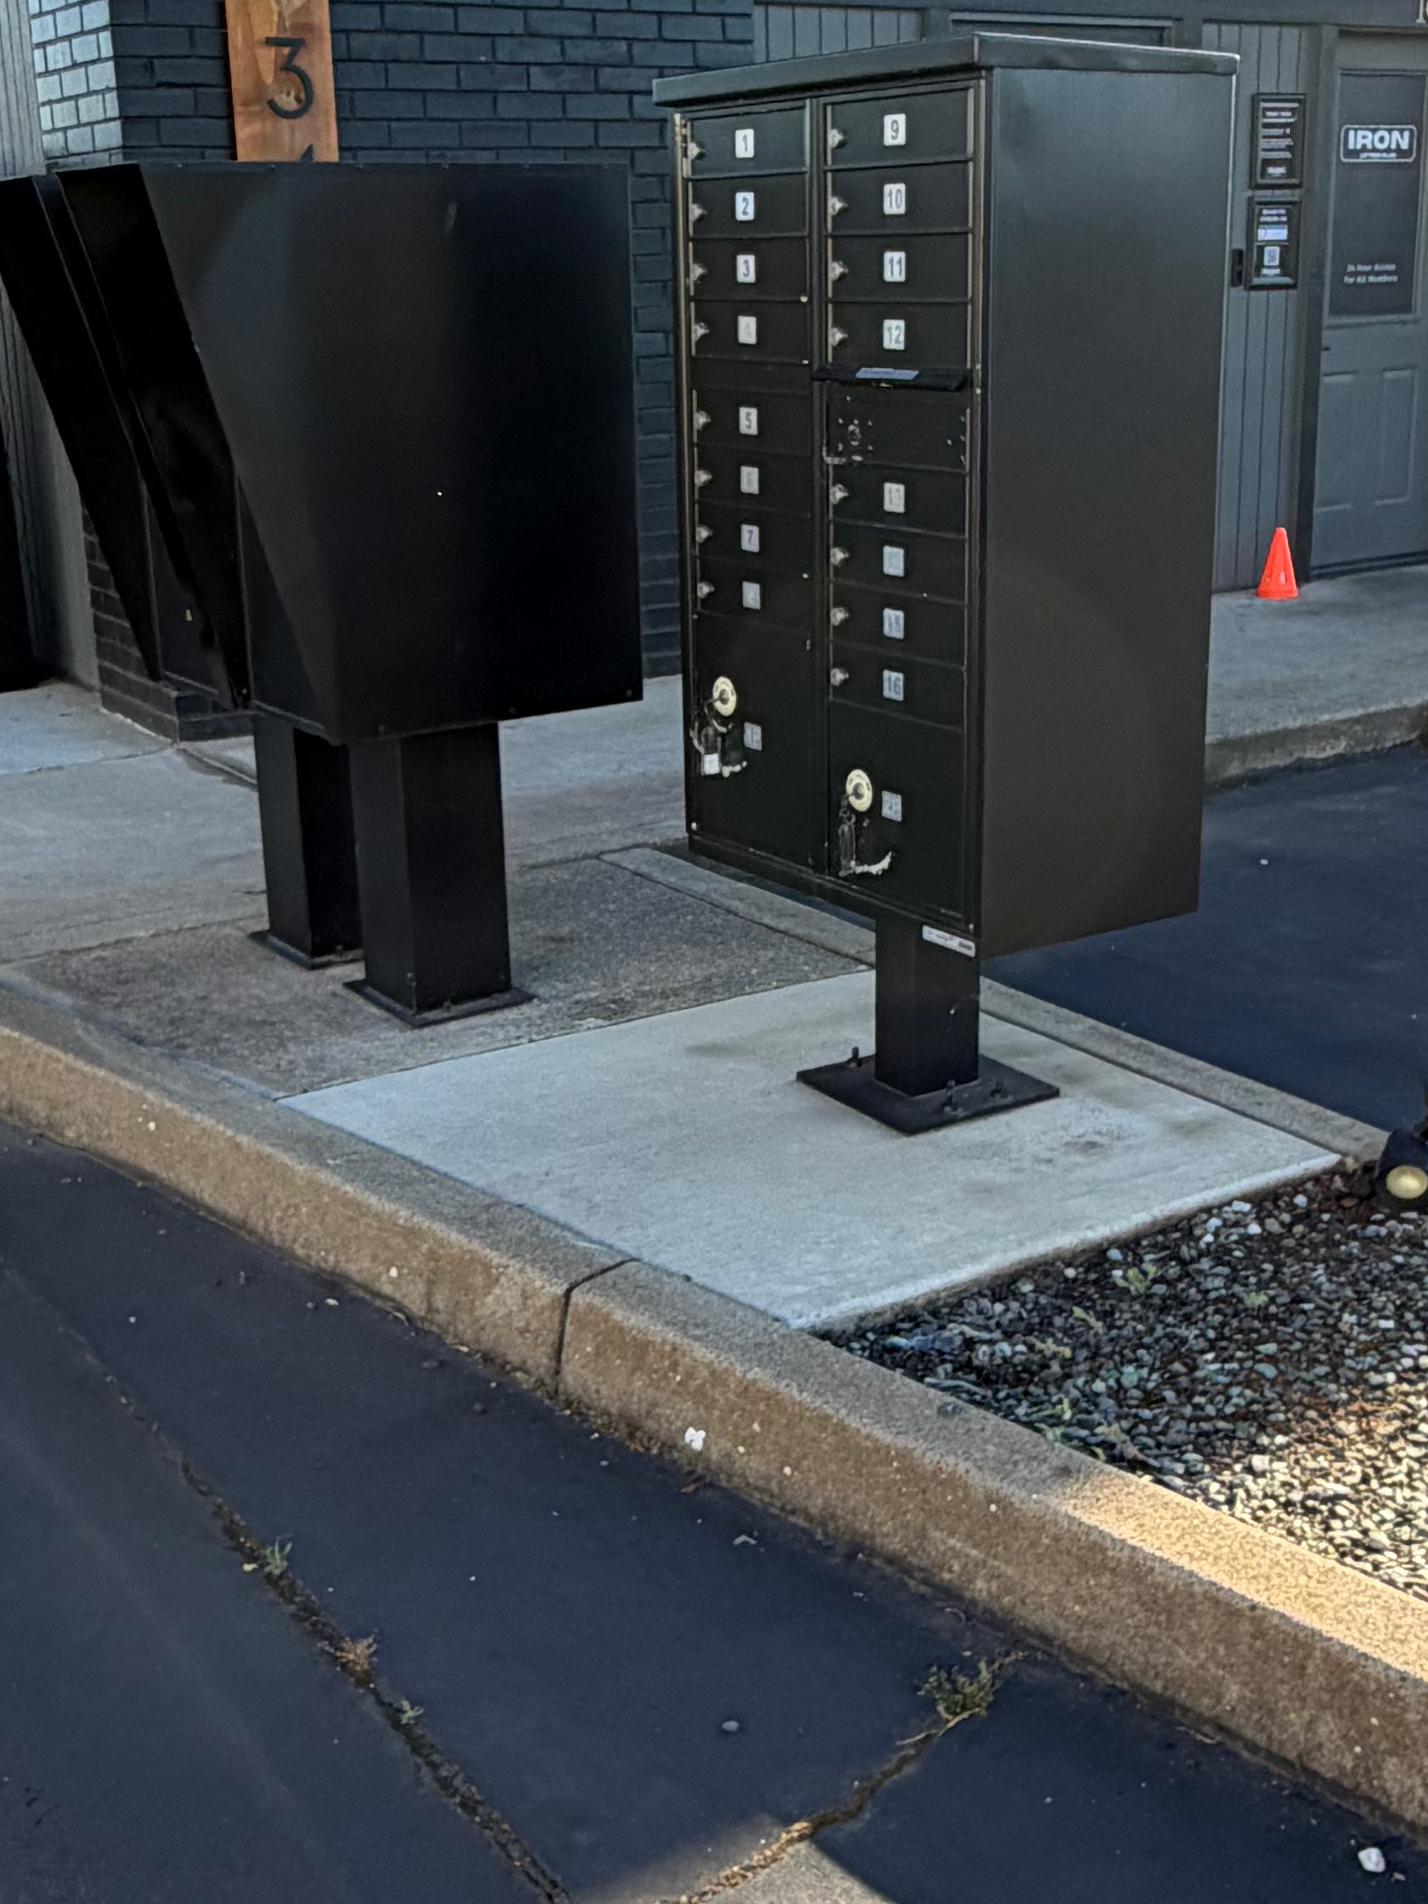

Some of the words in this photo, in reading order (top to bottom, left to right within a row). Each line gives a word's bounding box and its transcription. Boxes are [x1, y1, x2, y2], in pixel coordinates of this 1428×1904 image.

[264, 36, 314, 119] 3
[890, 120, 900, 140] 9
[1347, 130, 1410, 150] IRON
[741, 134, 749, 153] 1
[741, 197, 749, 216] 2
[887, 189, 903, 210] 10
[742, 260, 751, 279] 3
[888, 257, 903, 278] 11
[887, 325, 902, 345] 12
[744, 411, 753, 430] 5
[746, 528, 755, 546] 7
[887, 675, 901, 696] 16
